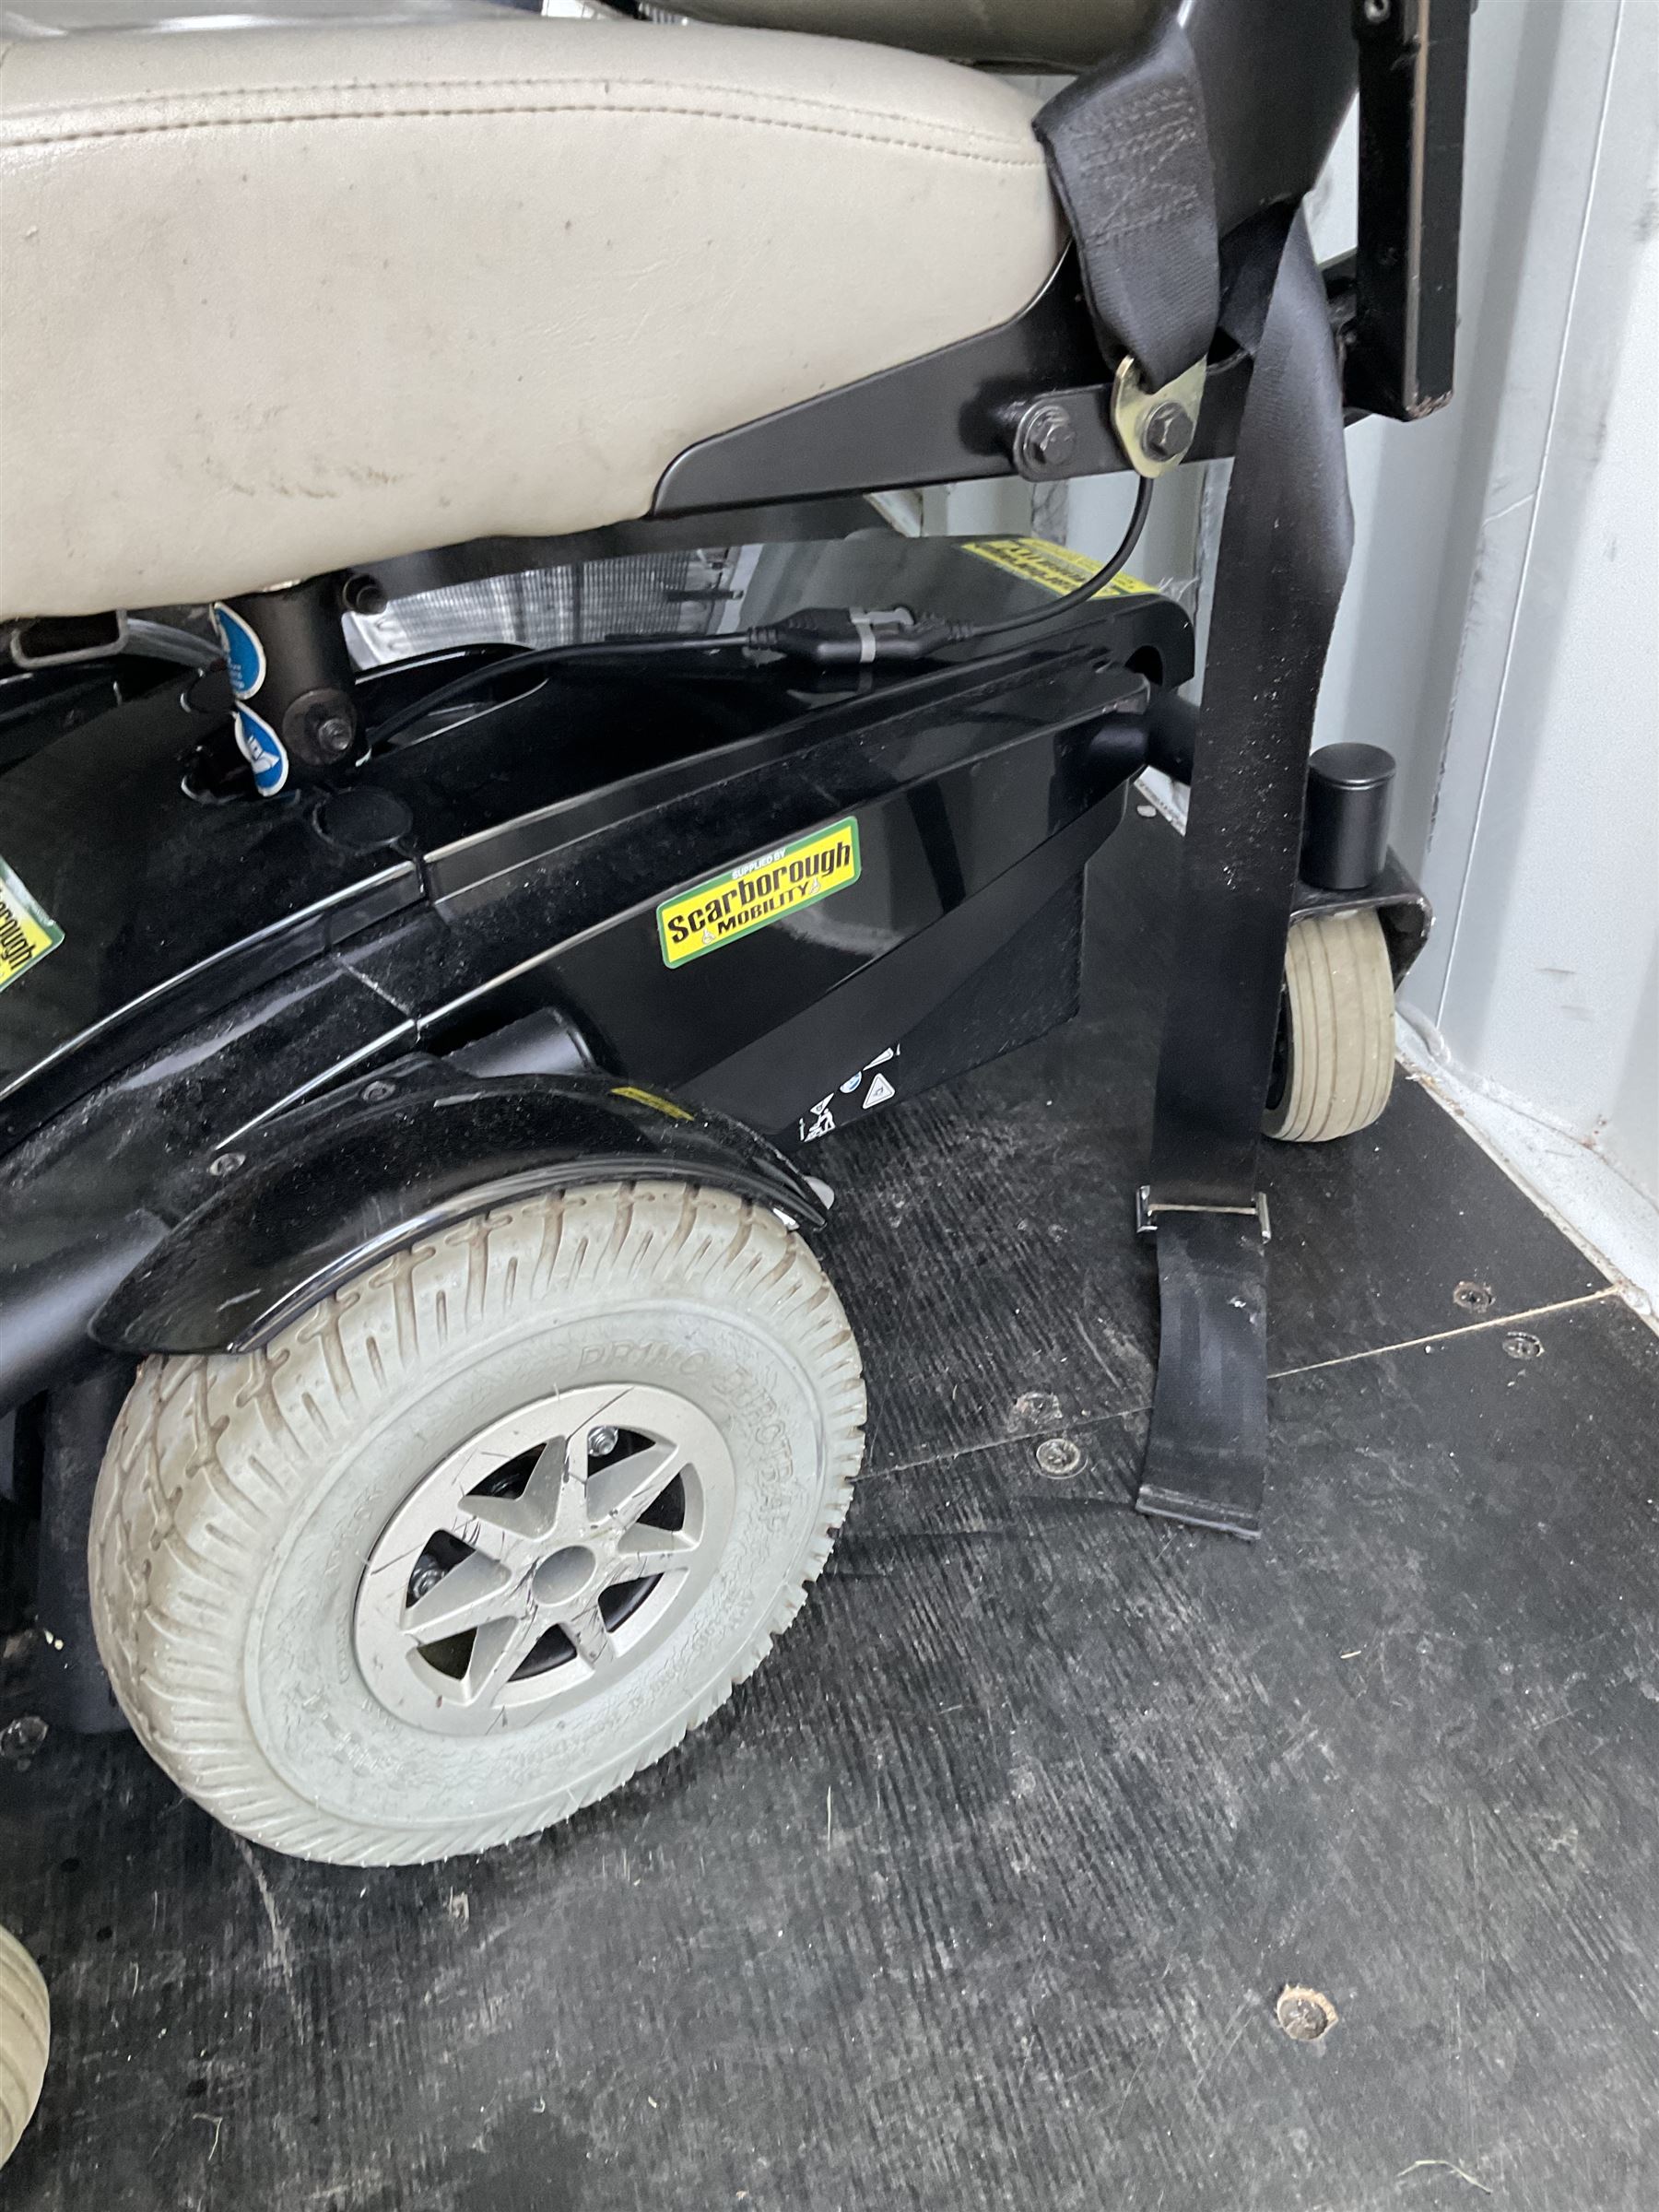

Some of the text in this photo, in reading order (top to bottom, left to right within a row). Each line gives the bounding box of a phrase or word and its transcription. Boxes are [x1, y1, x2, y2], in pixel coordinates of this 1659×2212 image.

[732, 848, 787, 879] SUPPLIED BY
[667, 841, 851, 944] Scarborough
[718, 881, 809, 935] MOBILITY
